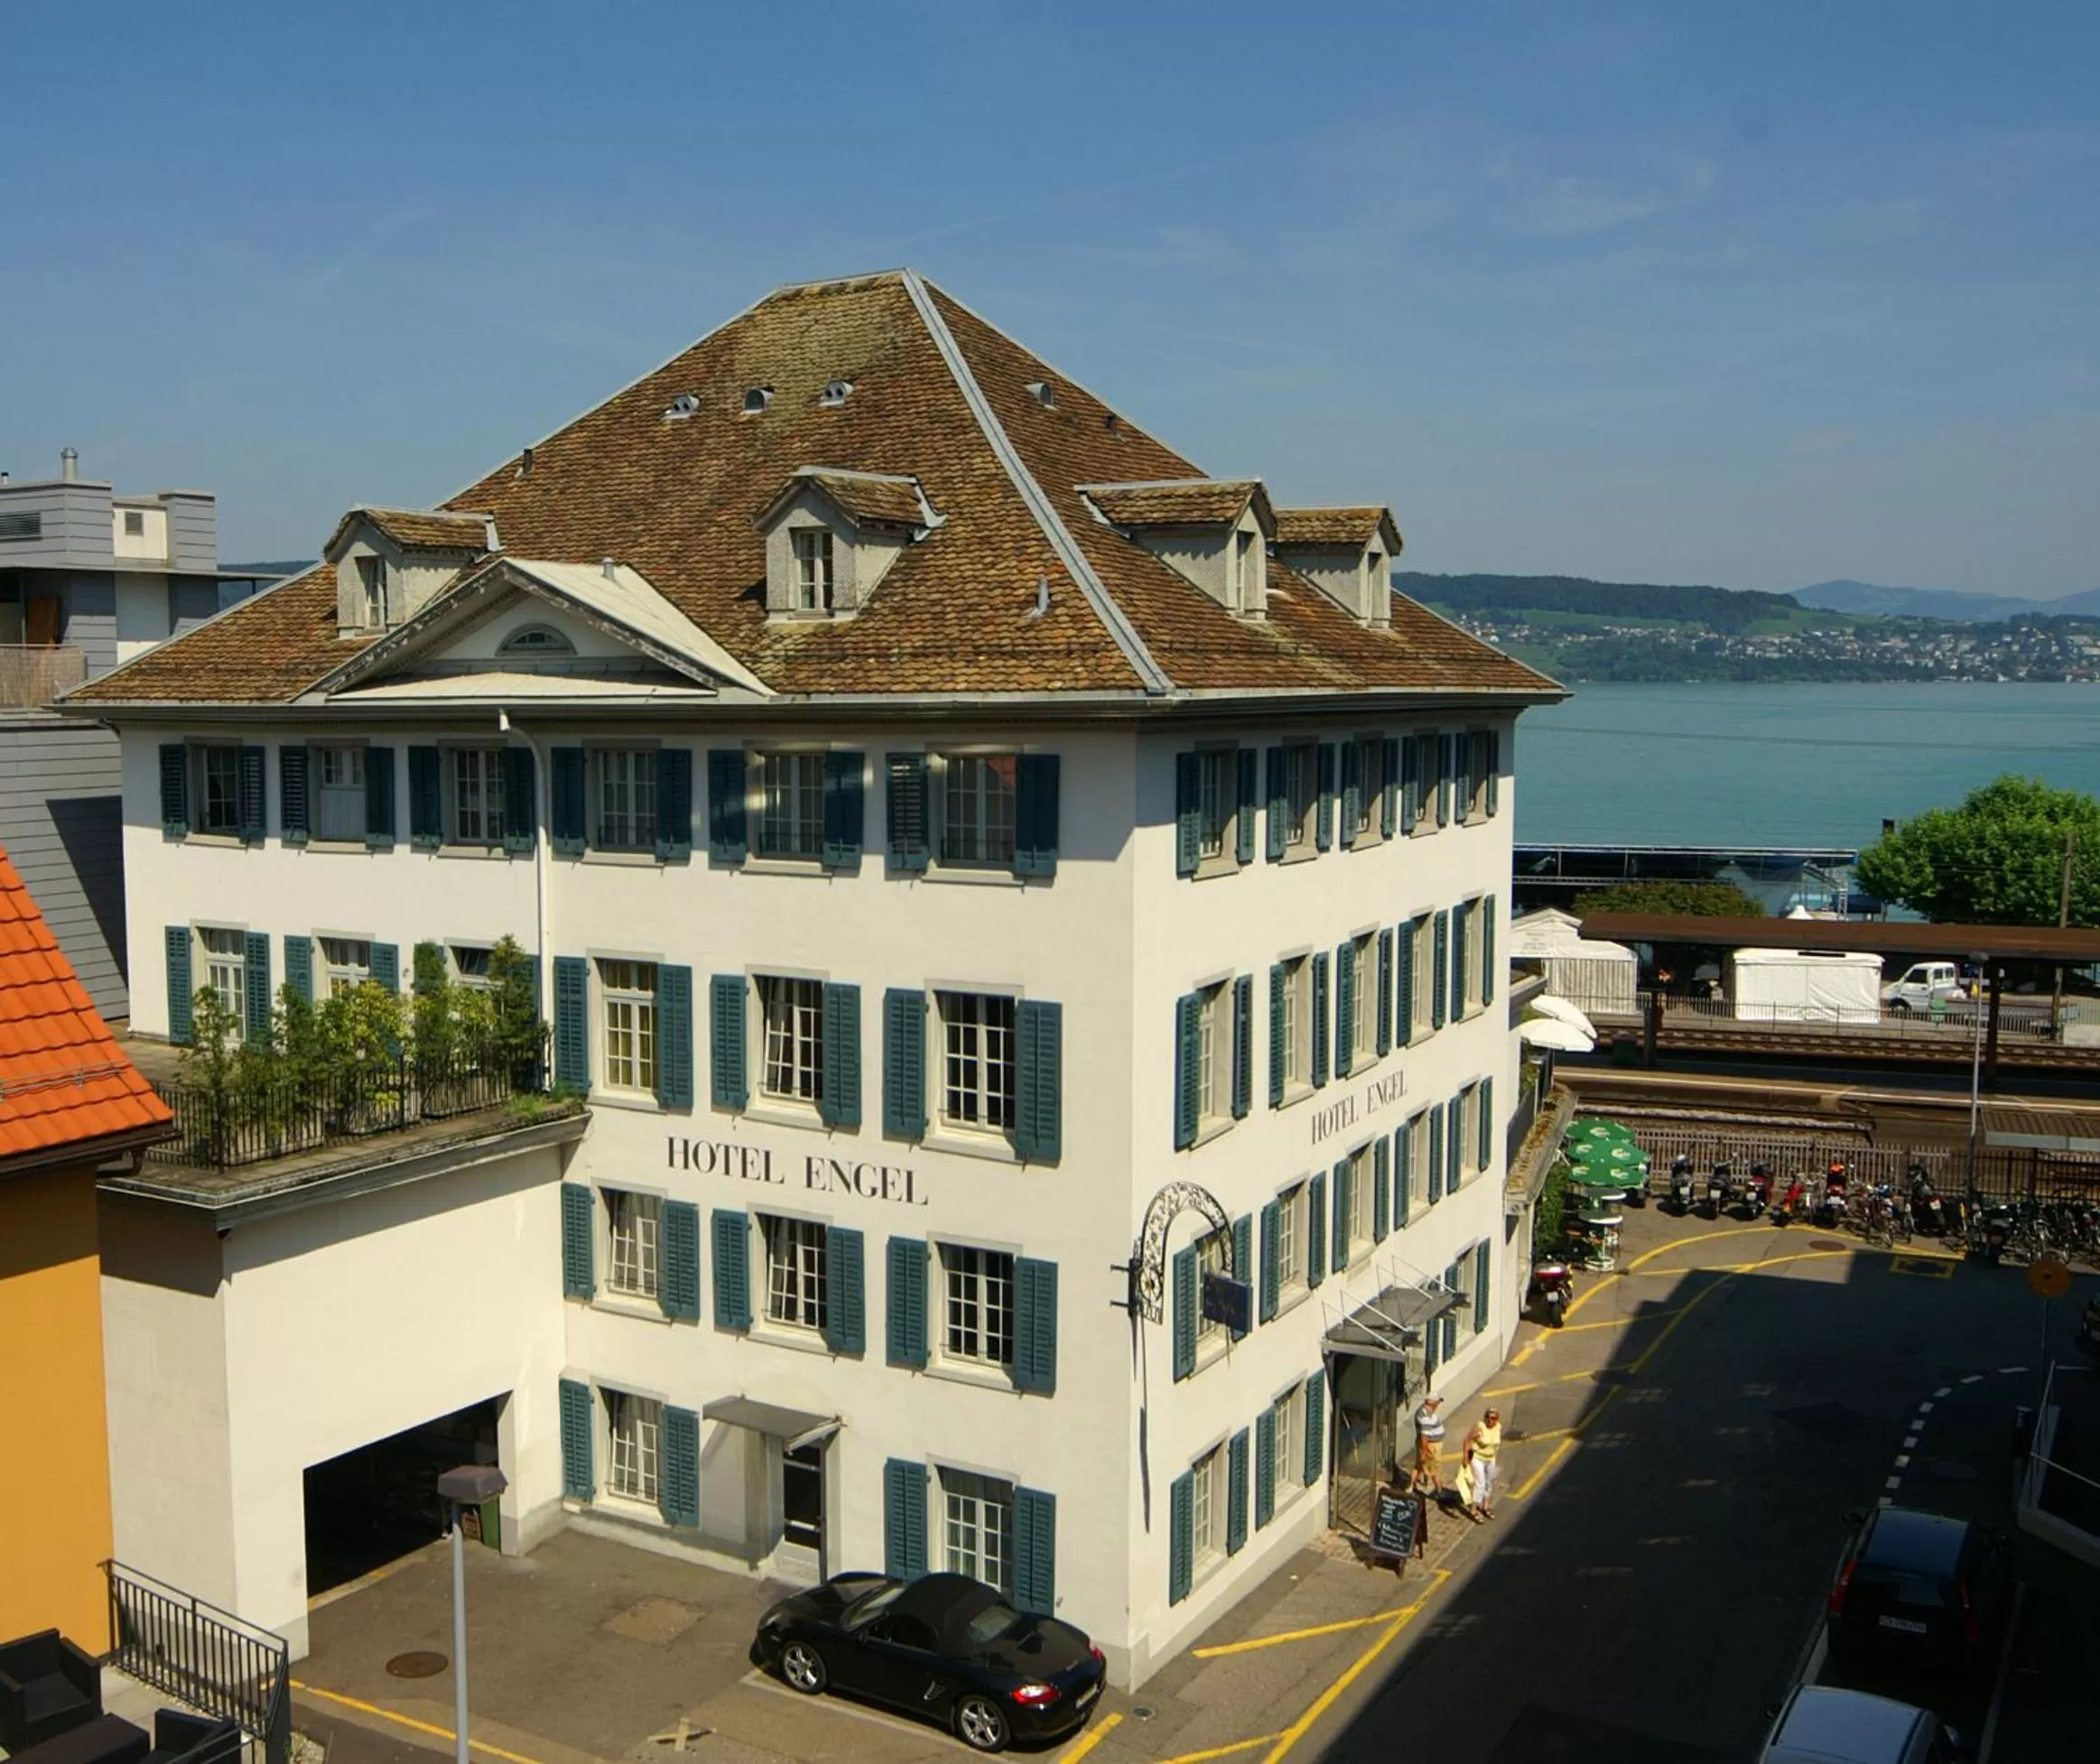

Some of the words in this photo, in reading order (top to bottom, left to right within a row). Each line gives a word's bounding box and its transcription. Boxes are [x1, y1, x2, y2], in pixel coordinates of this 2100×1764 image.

[1311, 1095, 1359, 1145] HOTEL
[1367, 1069, 1408, 1114] ENGEL
[667, 1137, 785, 1184] HOTEL
[805, 1156, 928, 1205] ENGEL
